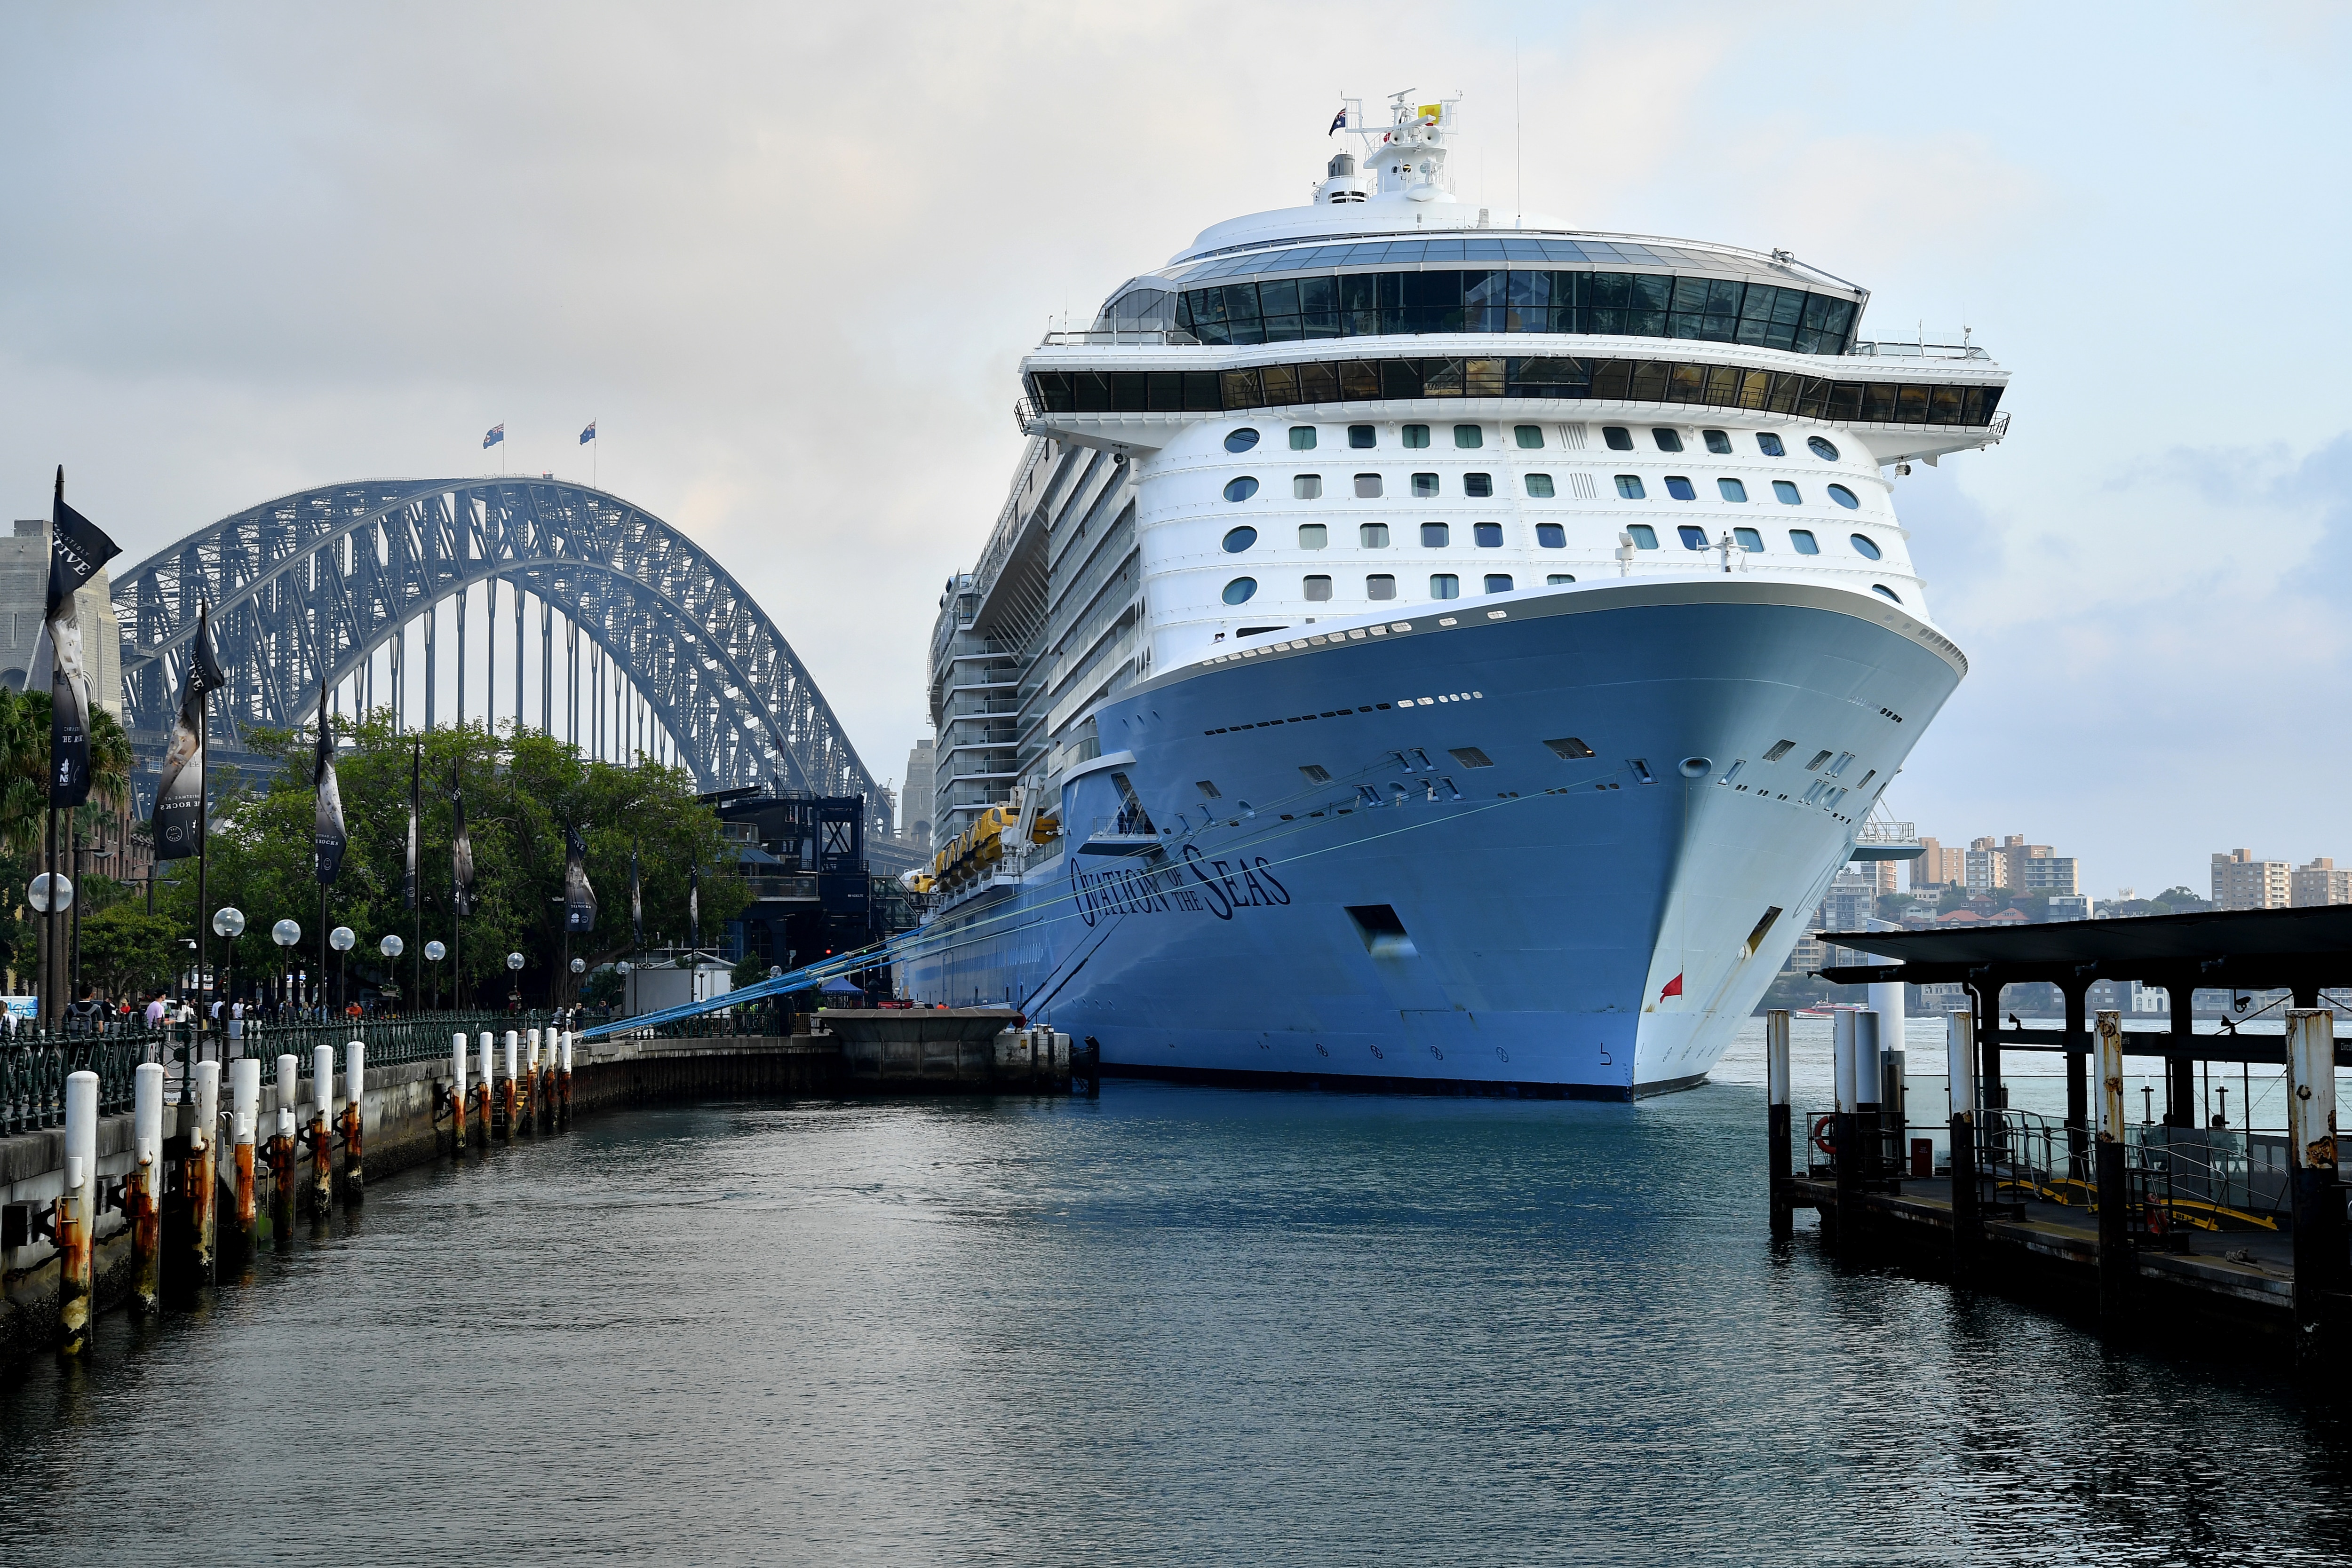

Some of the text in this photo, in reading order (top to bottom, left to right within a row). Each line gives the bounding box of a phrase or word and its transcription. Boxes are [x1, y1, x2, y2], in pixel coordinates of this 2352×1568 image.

[1071, 844, 1290, 927] OVATION OF THE SEAS
[2340, 1042, 2352, 1051] Circu
